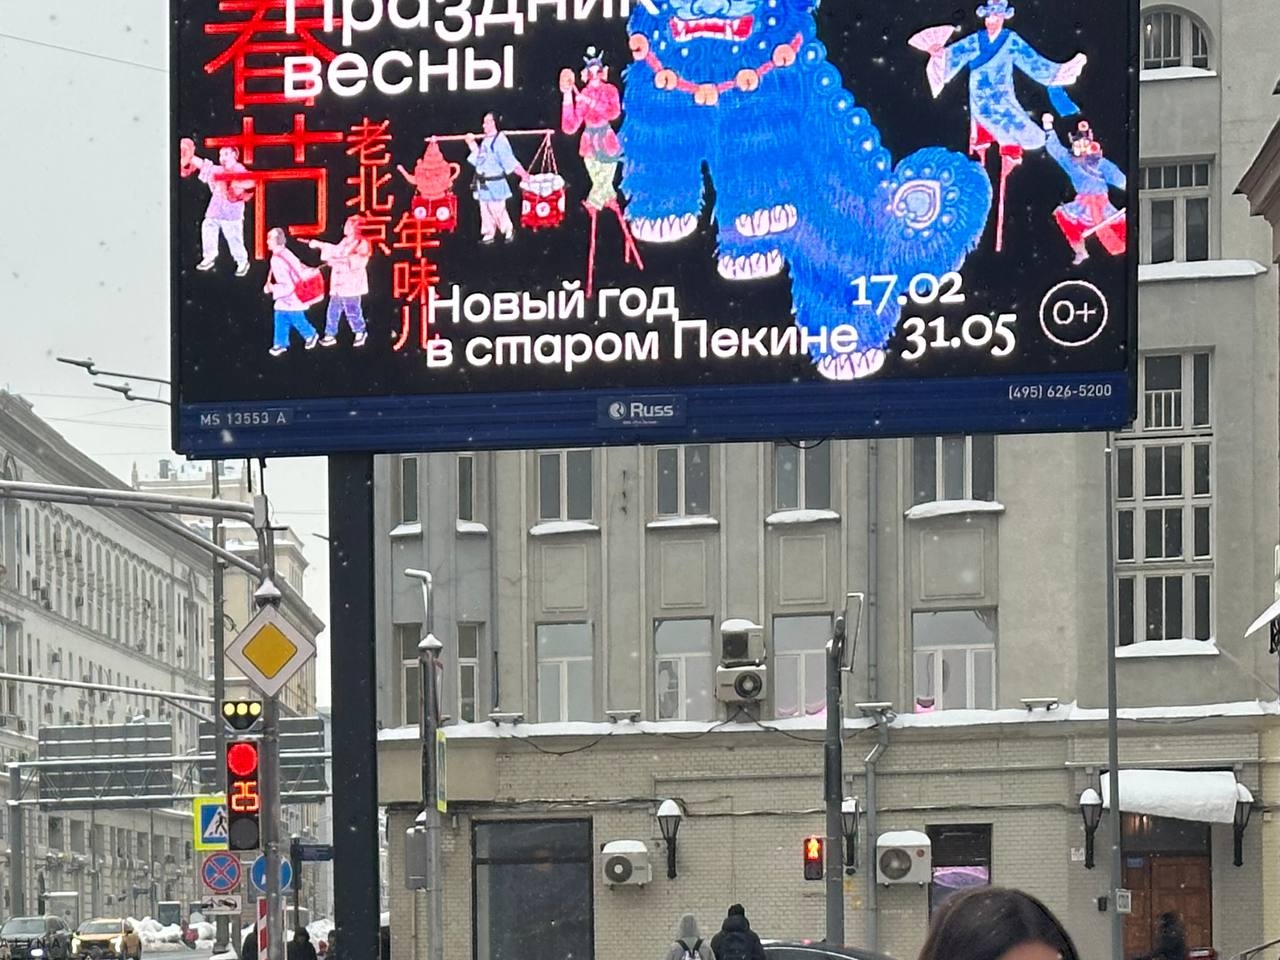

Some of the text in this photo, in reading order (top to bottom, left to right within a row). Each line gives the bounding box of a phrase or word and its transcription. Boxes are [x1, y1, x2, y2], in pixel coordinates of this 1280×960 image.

[284, 45, 514, 98] весны
[428, 281, 679, 323] Новый год
[850, 271, 965, 316] 17.02
[1053, 300, 1097, 324] 0+
[426, 319, 858, 372] в старом Пекине
[901, 313, 1017, 360] 31.05
[630, 402, 674, 417] Russ
[1008, 384, 1112, 399] (495) 626-5200
[200, 411, 286, 426] MS 13553 A
[230, 781, 259, 811] 25
